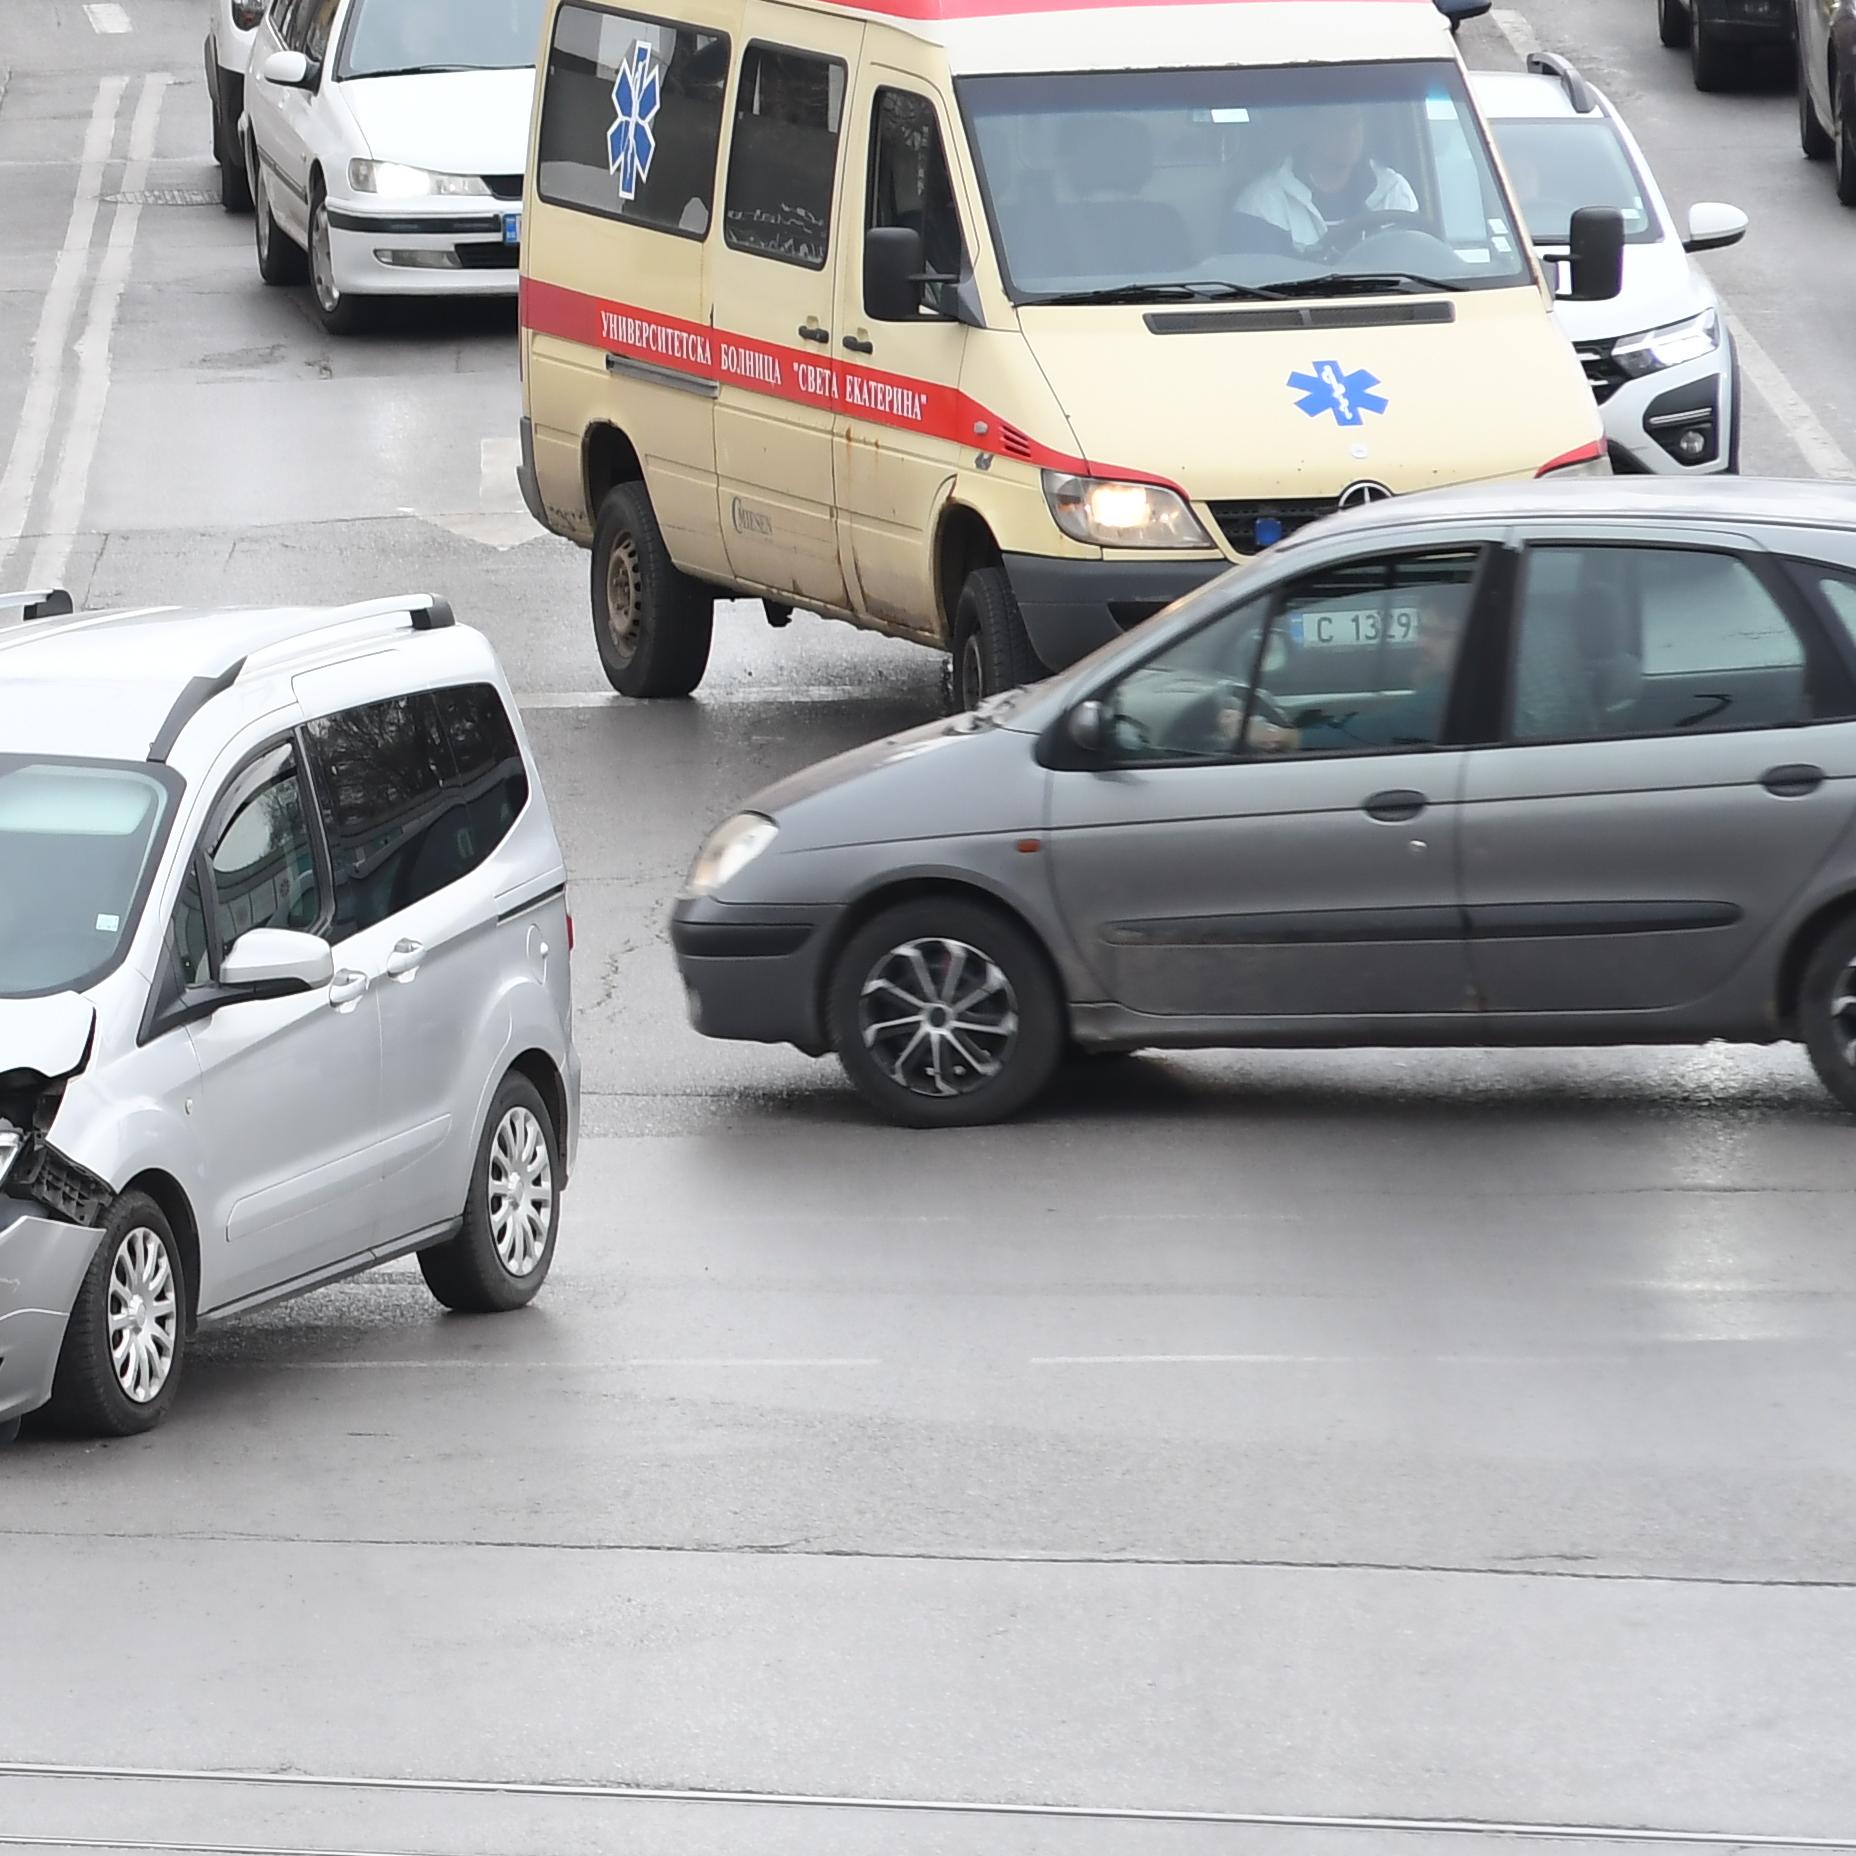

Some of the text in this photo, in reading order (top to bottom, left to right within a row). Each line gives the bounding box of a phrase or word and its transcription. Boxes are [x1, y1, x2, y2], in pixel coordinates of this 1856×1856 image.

[600, 310, 928, 421] УНИВЕРСИТЕТСКА БОЛНИЦА "СВЕТА ЕКАТЕРИНА"
